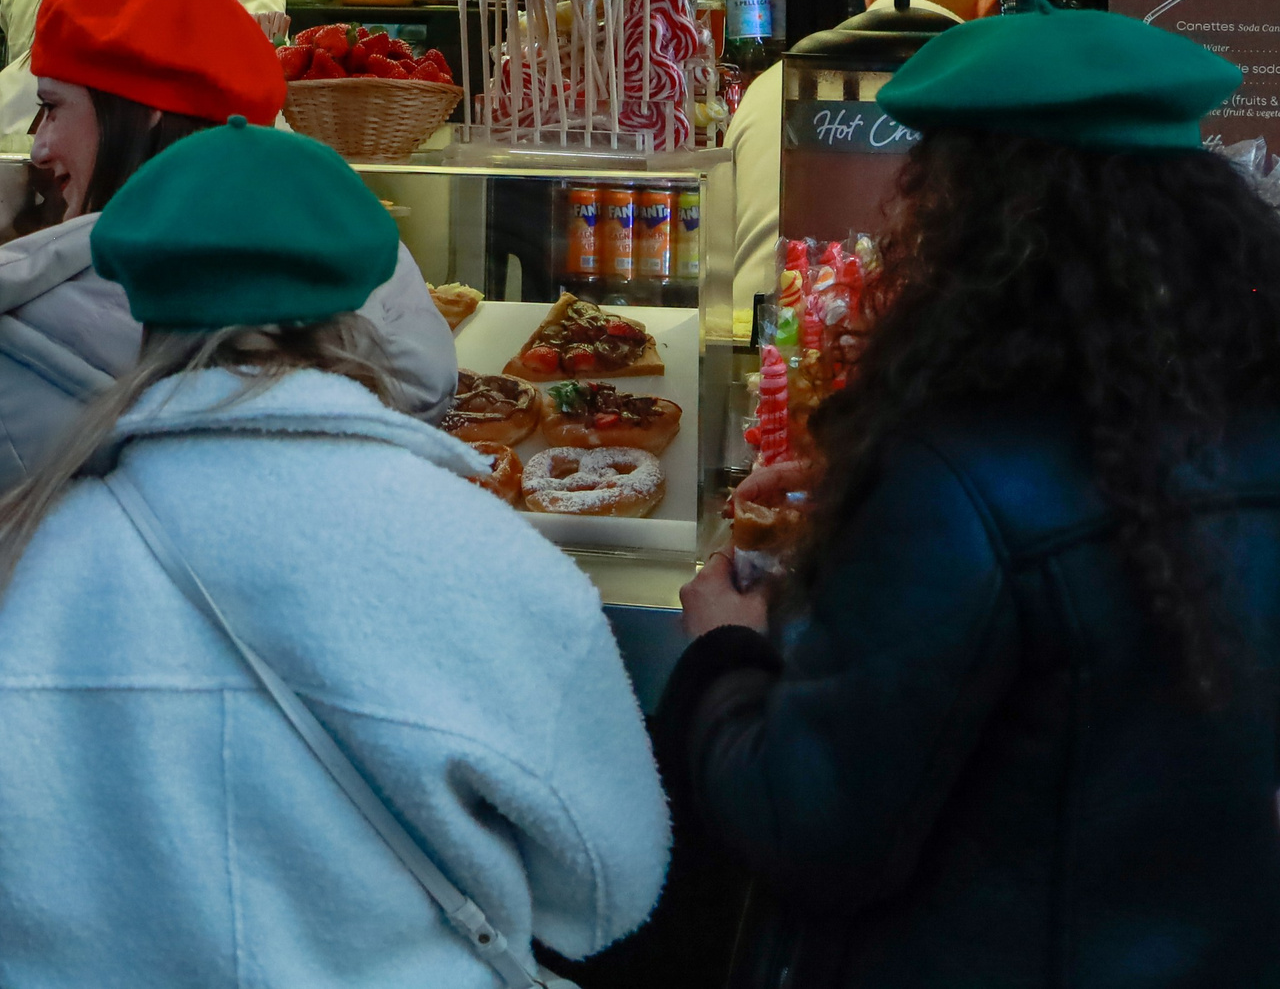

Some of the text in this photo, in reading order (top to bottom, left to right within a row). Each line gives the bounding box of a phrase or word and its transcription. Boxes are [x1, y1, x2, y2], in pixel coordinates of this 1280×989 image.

[1177, 21, 1260, 32] Canettes Soda
[1232, 94, 1267, 107] (fruits
[813, 109, 864, 146] Hot
